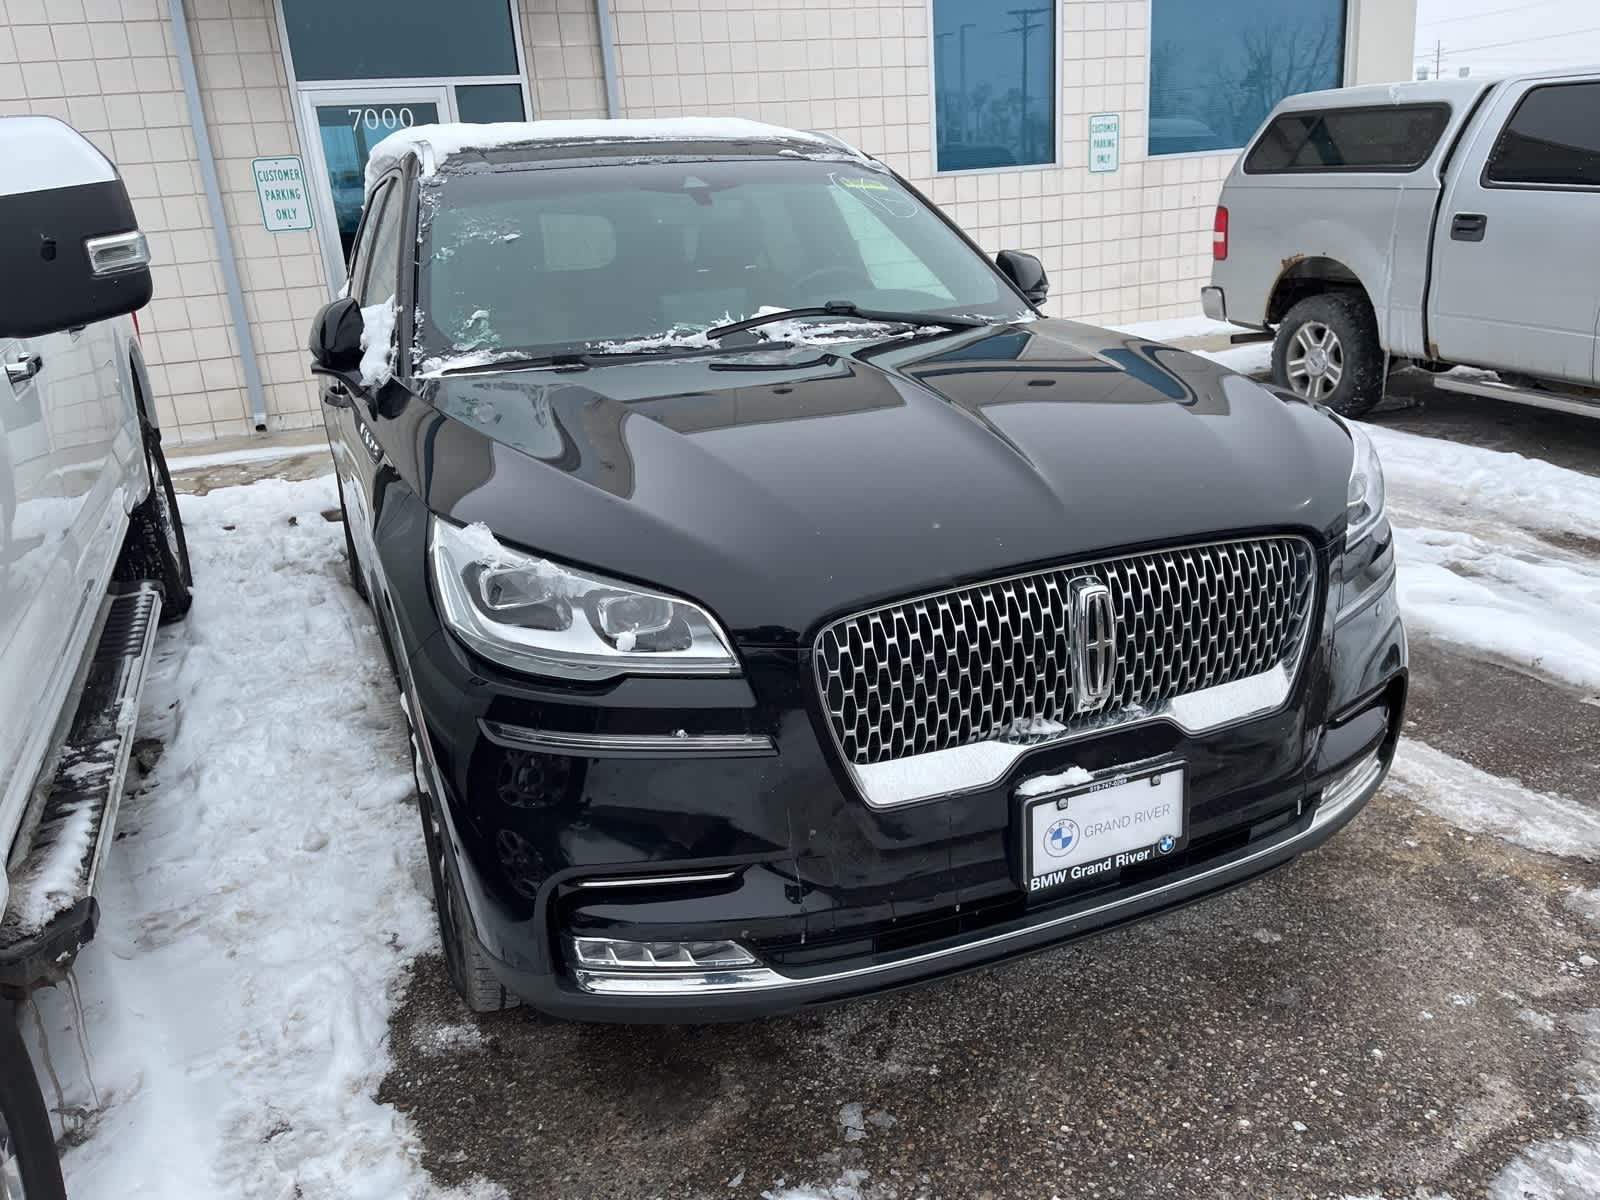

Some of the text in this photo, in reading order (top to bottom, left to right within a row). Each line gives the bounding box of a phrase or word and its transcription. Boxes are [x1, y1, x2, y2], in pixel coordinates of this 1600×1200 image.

[348, 107, 414, 131] 7000
[1093, 139, 1115, 148] PARKING
[1097, 154, 1110, 163] ONLY
[257, 169, 301, 182] CUSTOMER
[265, 188, 301, 200] PARKING
[276, 208, 298, 220] ONLY
[1084, 803, 1171, 838] GRAND RIVER
[1030, 849, 1151, 892] BMW Grand River
